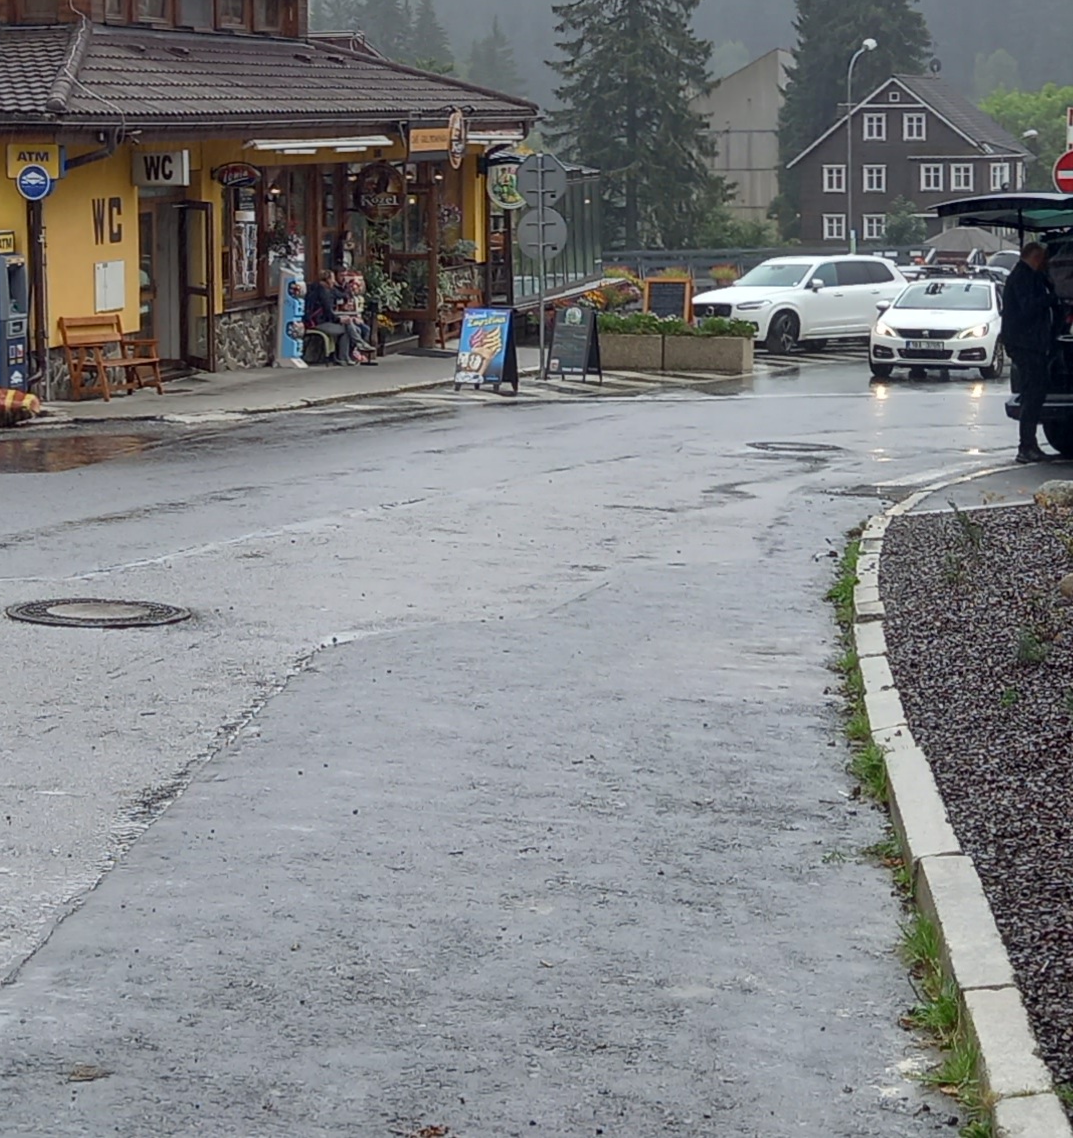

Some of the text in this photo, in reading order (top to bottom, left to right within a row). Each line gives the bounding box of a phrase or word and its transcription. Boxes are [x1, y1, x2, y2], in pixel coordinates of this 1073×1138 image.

[17, 150, 49, 162] ATM
[143, 154, 174, 181] WC
[360, 194, 399, 207] Kozel
[91, 196, 123, 246] WC
